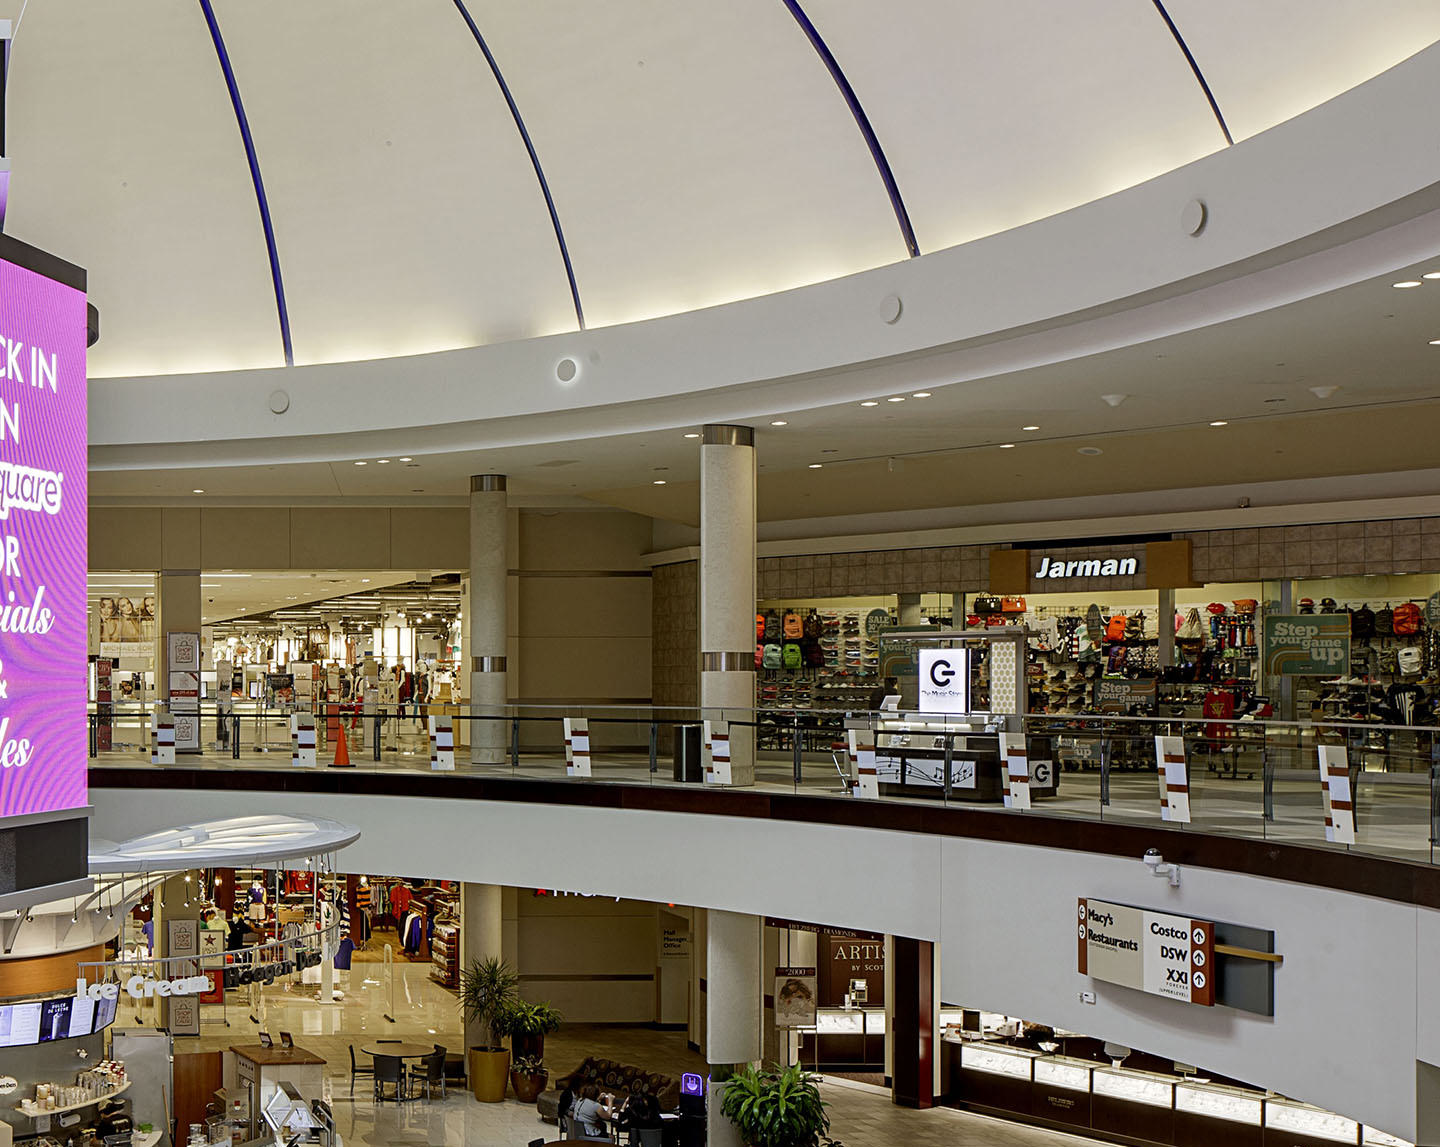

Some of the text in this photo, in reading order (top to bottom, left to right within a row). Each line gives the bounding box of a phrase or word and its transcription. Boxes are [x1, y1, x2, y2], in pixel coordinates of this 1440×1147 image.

[31, 346, 57, 394] IN
[1036, 557, 1137, 579] Jarman
[1274, 622, 1319, 639] Step
[1270, 636, 1342, 650] your game
[1310, 647, 1345, 666] up
[1097, 691, 1147, 704] your game
[1100, 682, 1132, 695] Step
[1088, 909, 1114, 927] Macy's
[1088, 928, 1139, 952] Restaurants
[1150, 922, 1188, 940] Costco
[1160, 945, 1188, 962] DSW
[1166, 968, 1188, 985] XXI
[77, 975, 210, 1000] Ice Cream
